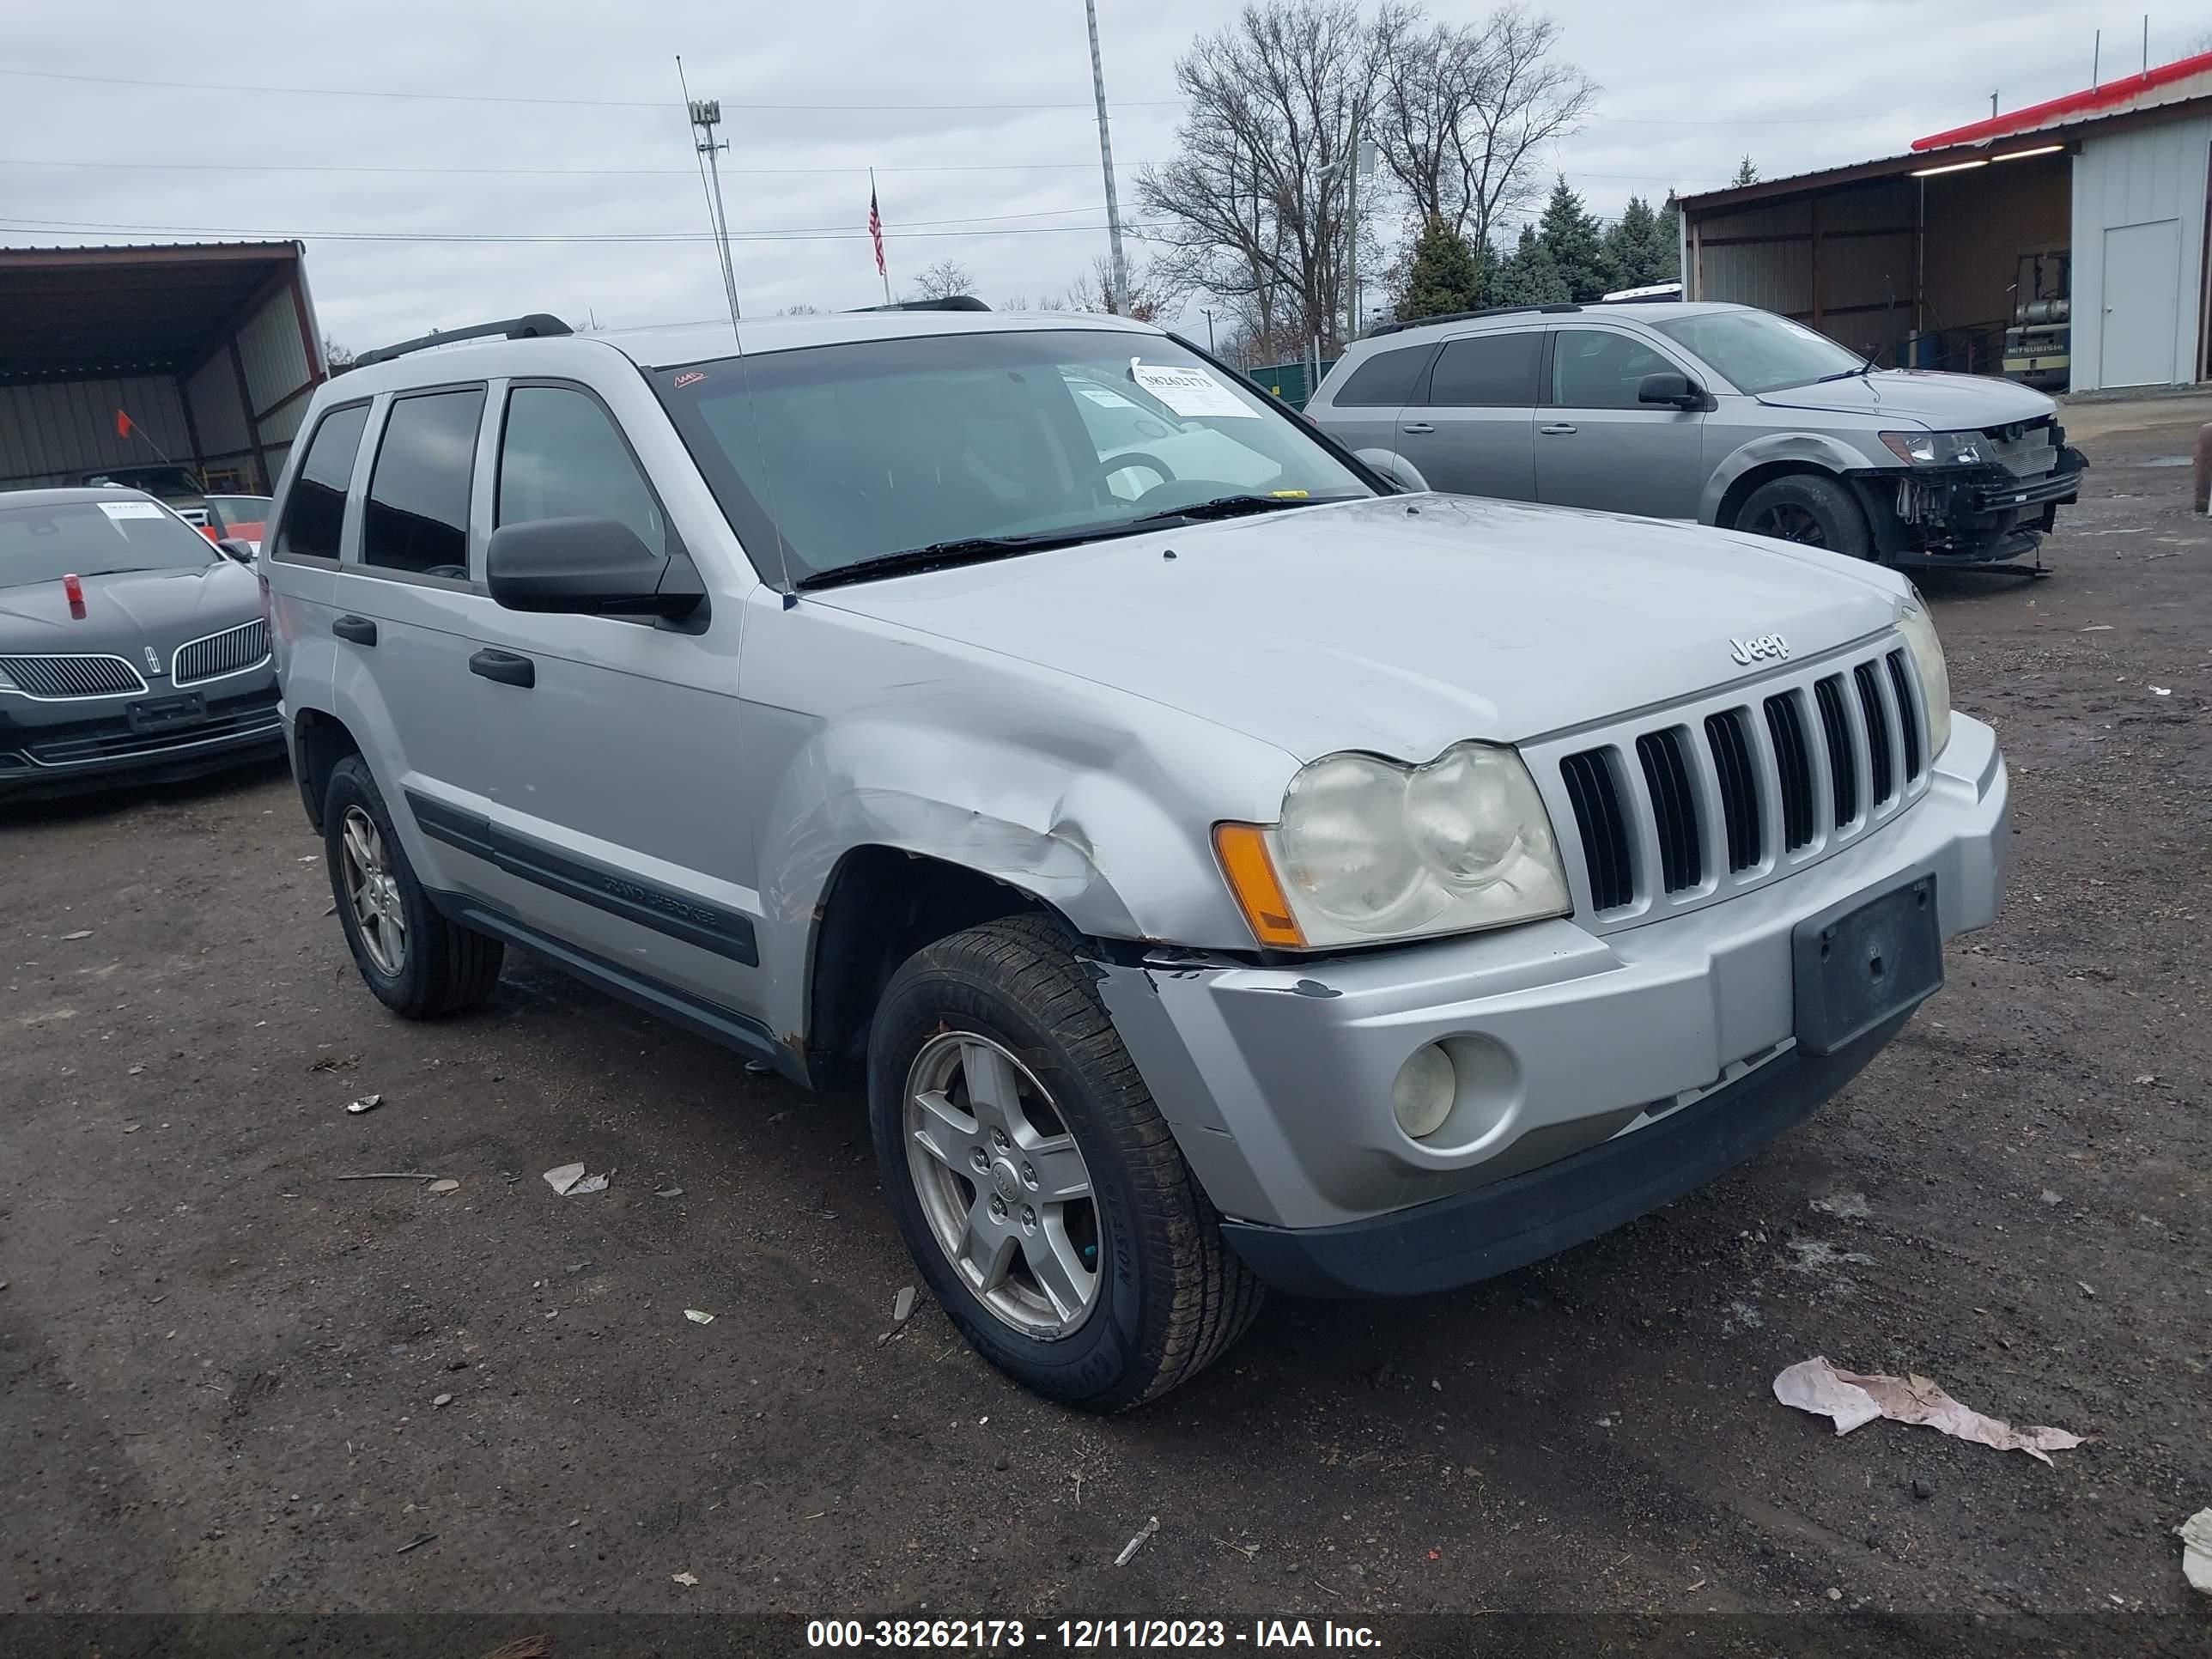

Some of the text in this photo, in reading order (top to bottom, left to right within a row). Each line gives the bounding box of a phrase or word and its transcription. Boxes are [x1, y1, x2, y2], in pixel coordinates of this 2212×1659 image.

[2008, 344, 2063, 354] MITSUBISHI
[1140, 375, 1213, 388] 38262173
[1730, 633, 1790, 665] Jeep
